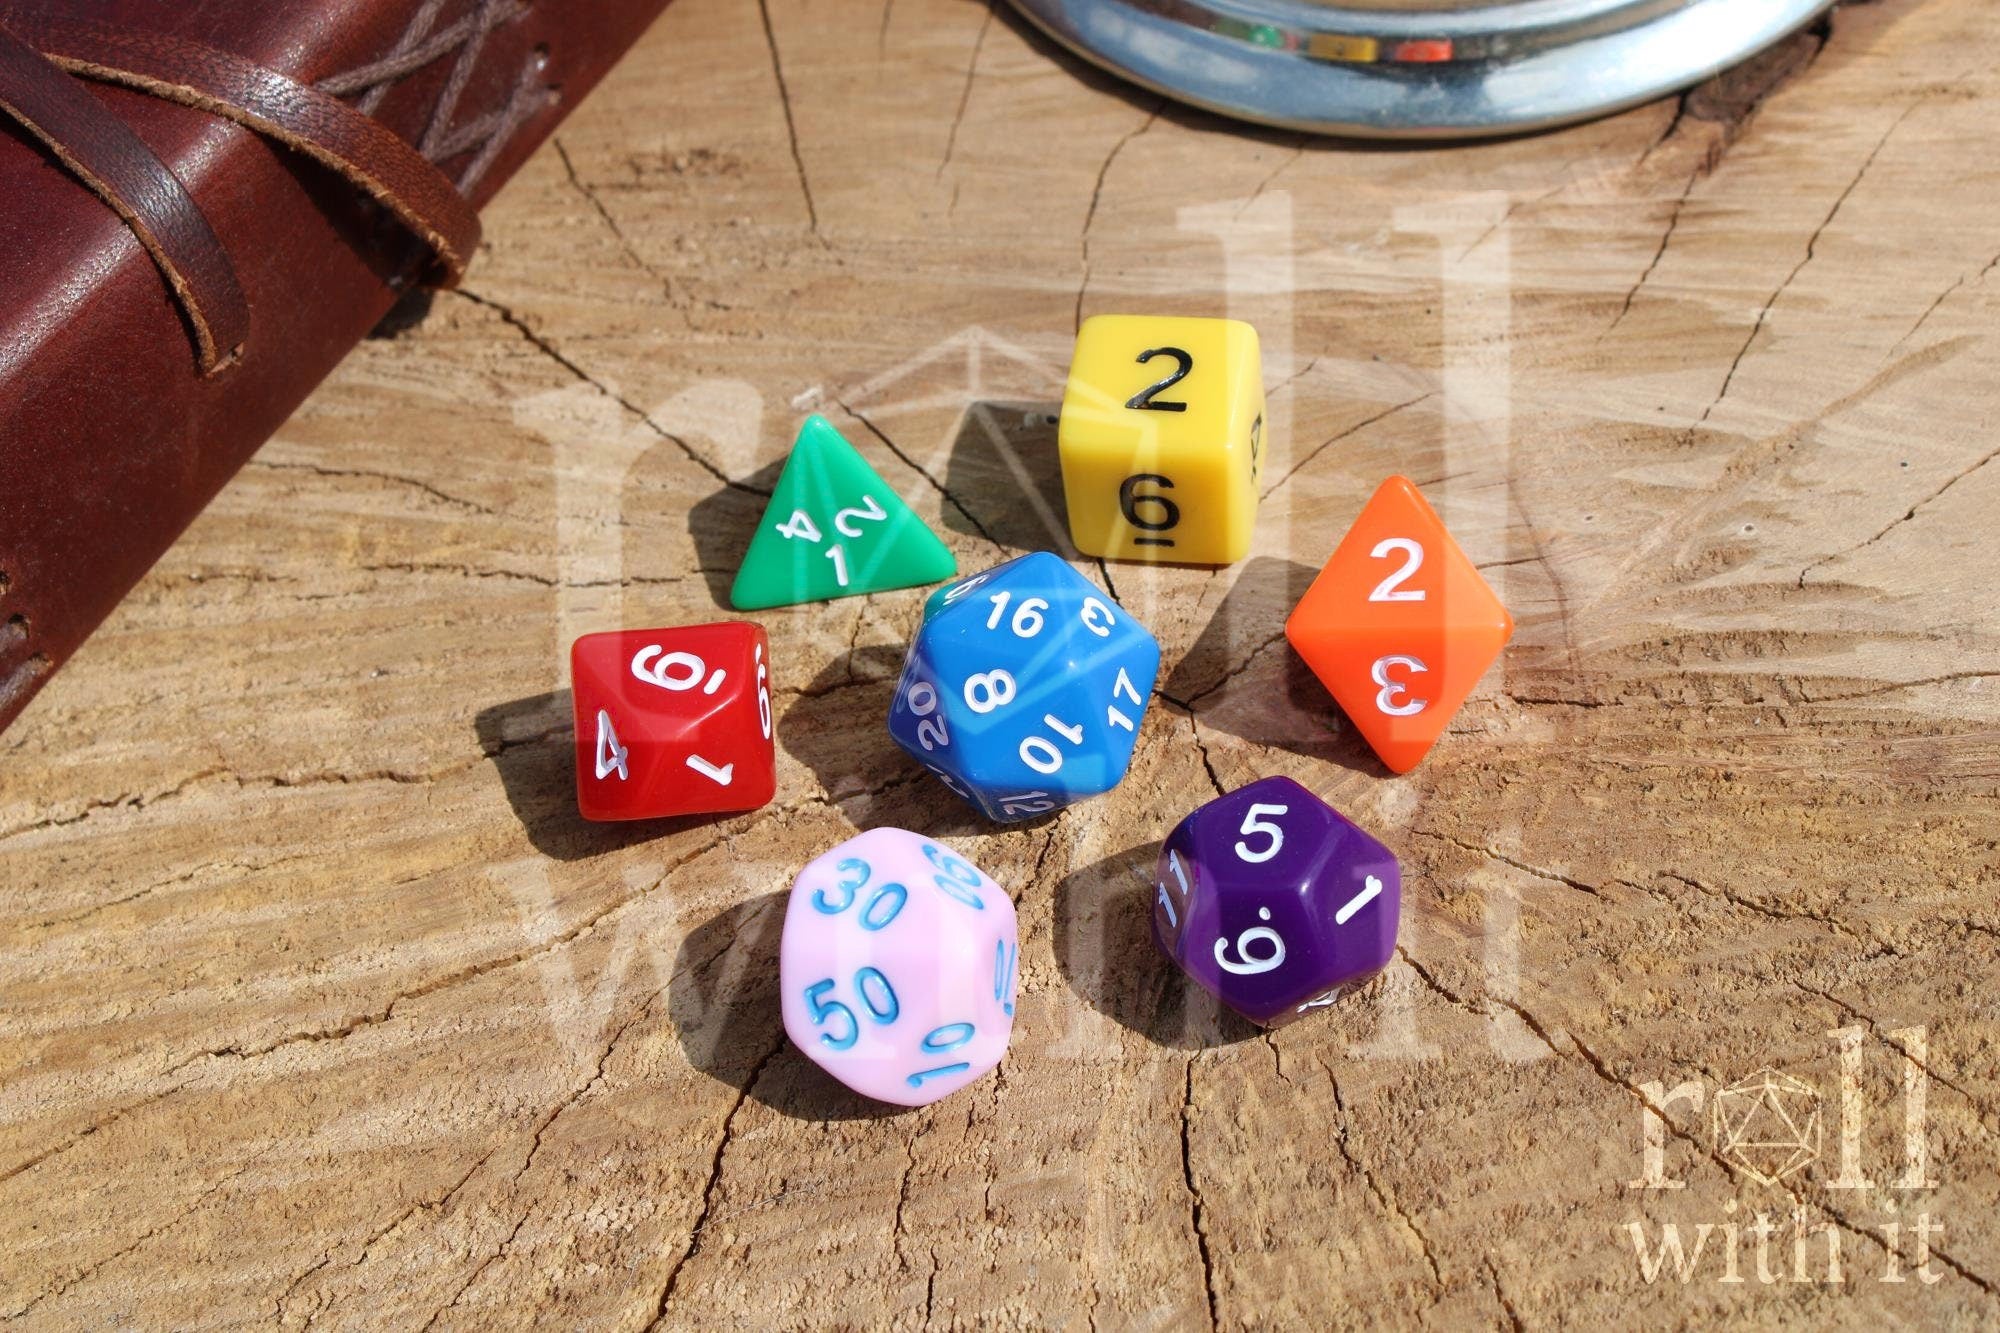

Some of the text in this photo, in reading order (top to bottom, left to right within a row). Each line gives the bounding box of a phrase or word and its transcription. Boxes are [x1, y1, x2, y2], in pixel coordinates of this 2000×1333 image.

[1125, 347, 1193, 412] 2
[776, 508, 822, 542] 4
[835, 495, 887, 537] 2
[1119, 473, 1180, 547] 6
[825, 544, 848, 586] 1
[1368, 537, 1426, 602] 2
[987, 591, 1048, 638] 16
[1080, 597, 1115, 637] 3
[908, 682, 948, 750] 20
[964, 669, 1016, 714] 8
[1107, 667, 1141, 731] 17
[1371, 654, 1428, 716] 3
[595, 709, 628, 780] 4
[686, 753, 734, 786] 1
[1019, 714, 1083, 774] 10
[1235, 803, 1288, 863] 5
[811, 857, 908, 931] 30
[1159, 849, 1188, 928] 11
[1335, 875, 1383, 925] 1
[804, 966, 900, 1051] 50
[906, 1022, 975, 1088] 10
